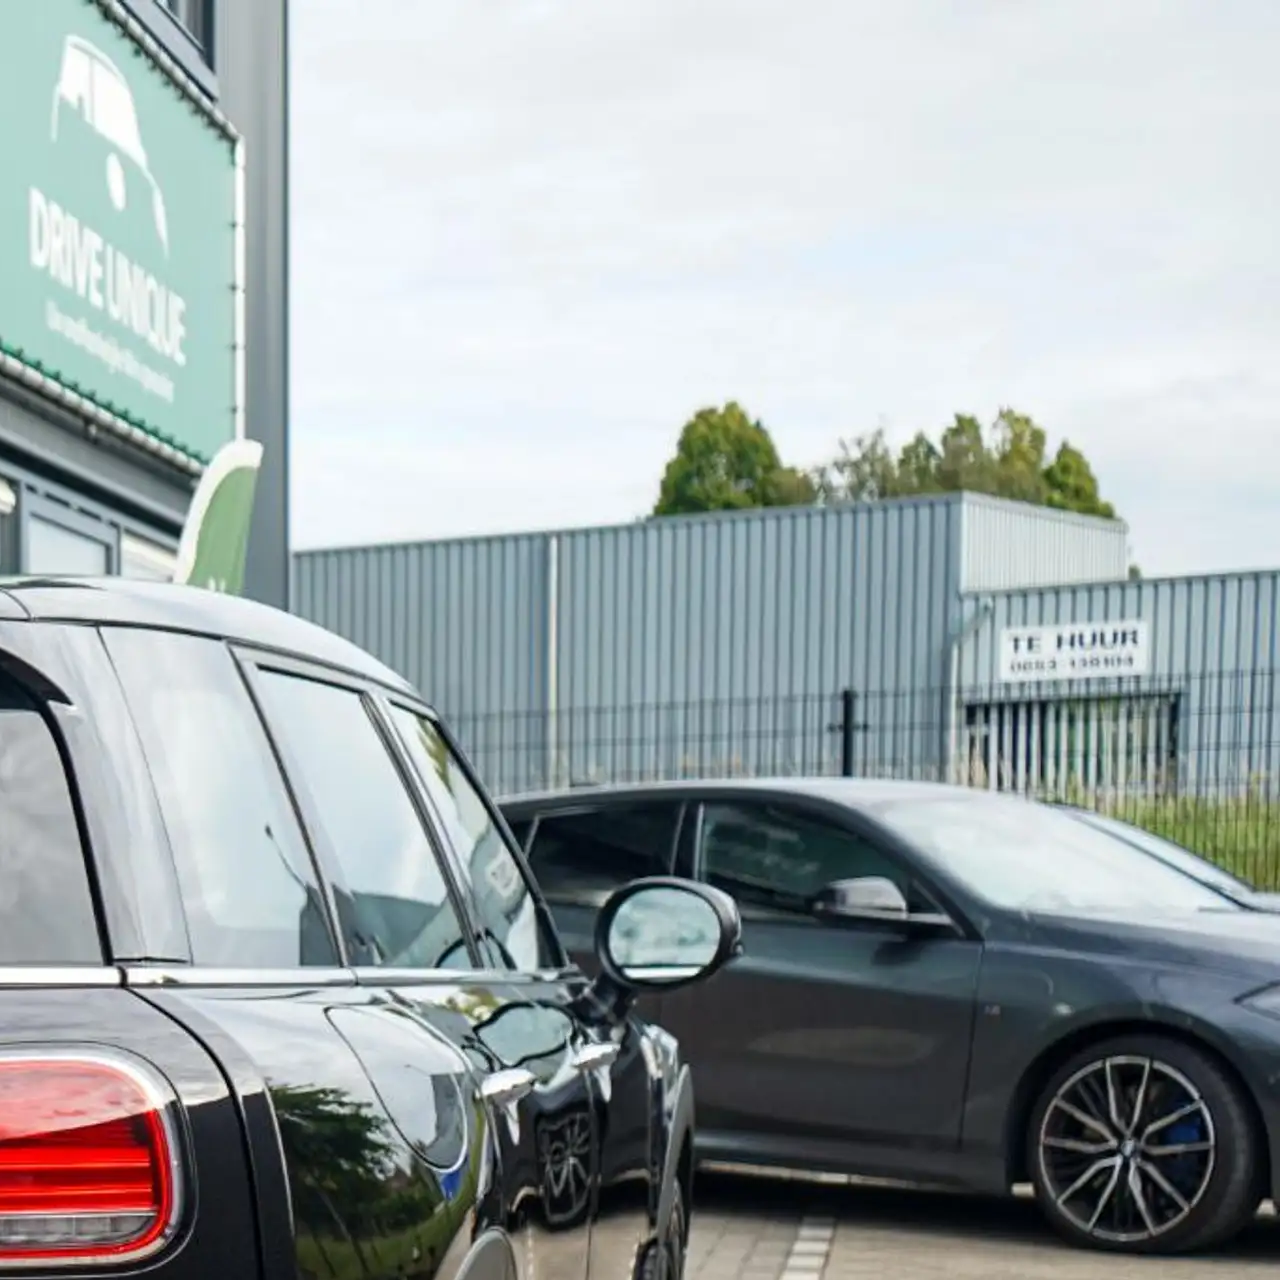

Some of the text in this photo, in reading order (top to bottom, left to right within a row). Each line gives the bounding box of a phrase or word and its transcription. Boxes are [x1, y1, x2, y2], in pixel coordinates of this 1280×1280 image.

[30, 187, 104, 309] DRIVE
[106, 243, 186, 367] UNIQUE
[1009, 629, 1140, 653] TE HUUR
